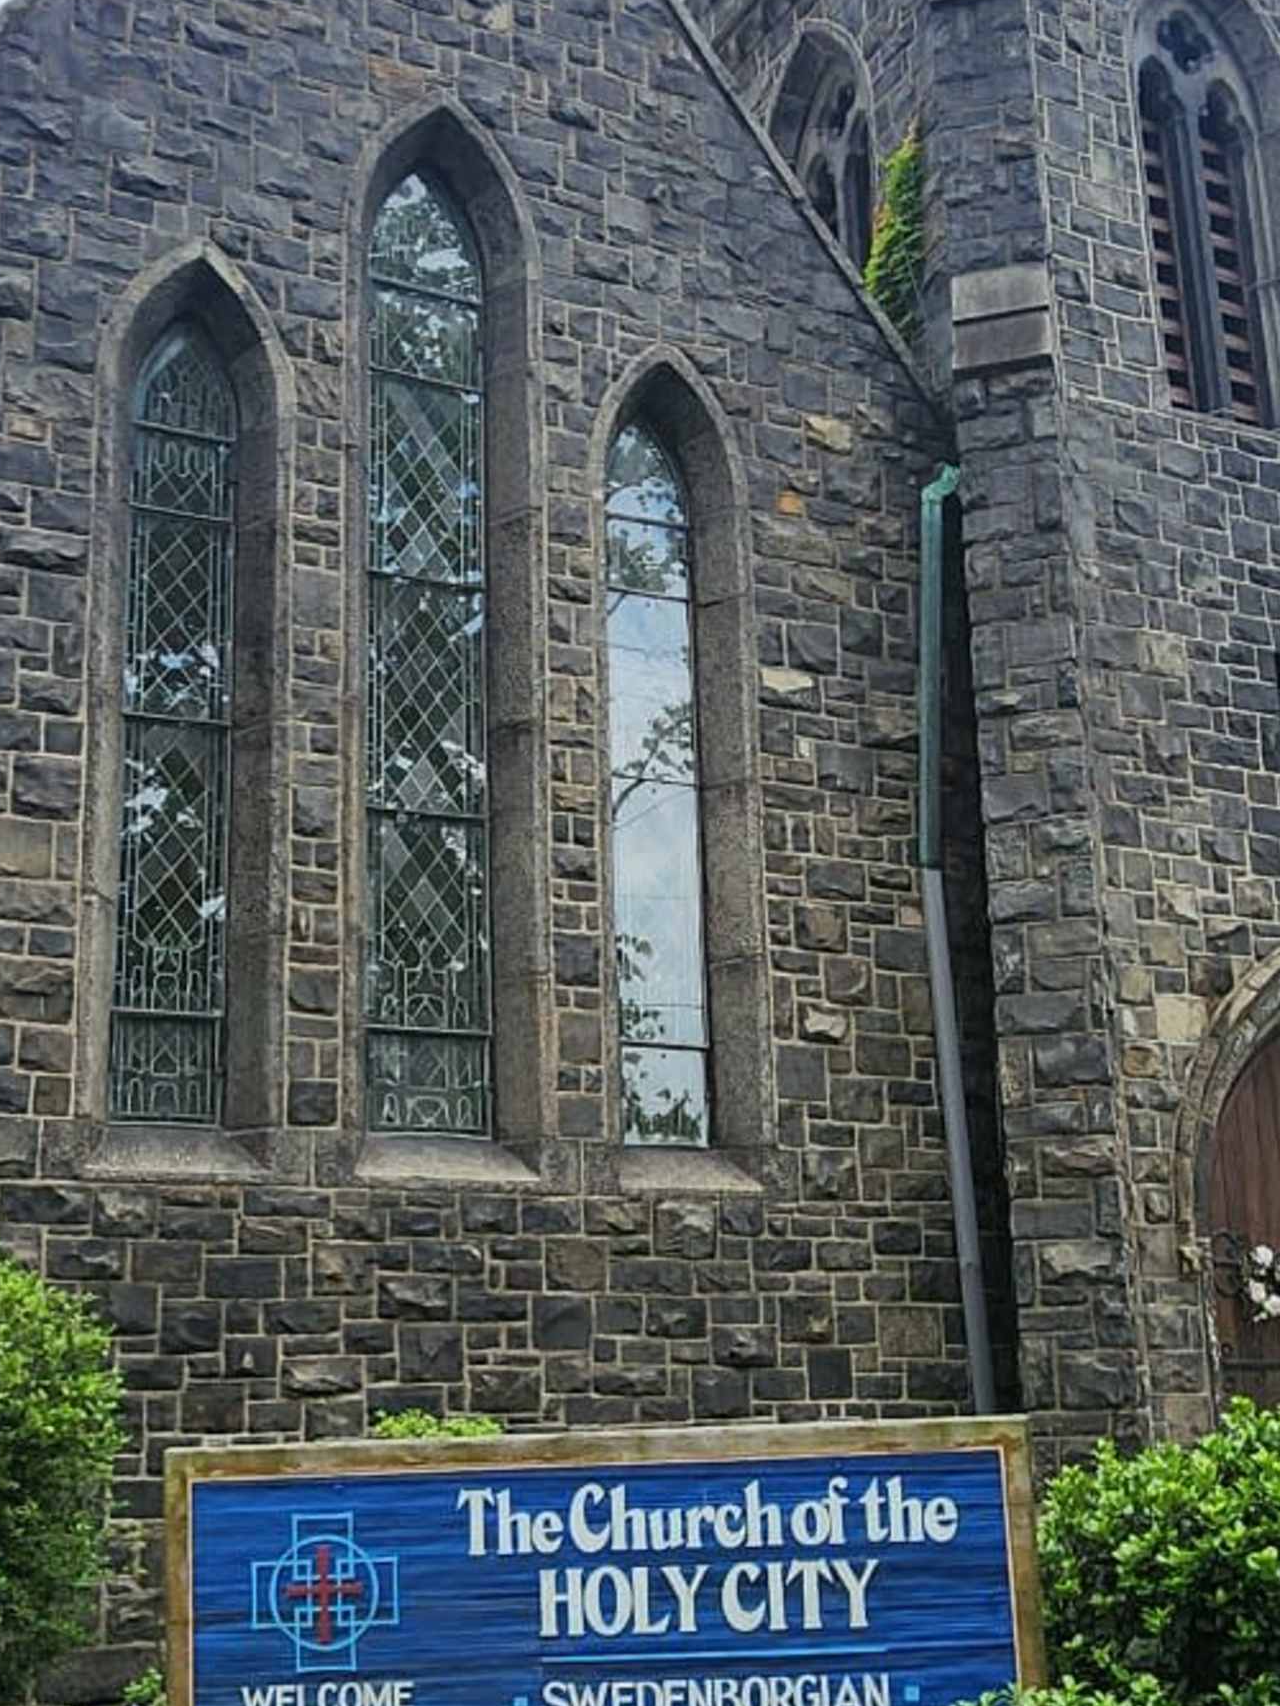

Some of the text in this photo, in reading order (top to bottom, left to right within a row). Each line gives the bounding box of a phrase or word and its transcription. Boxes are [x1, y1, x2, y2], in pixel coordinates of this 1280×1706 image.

[457, 1474, 959, 1558] The Church of the
[539, 1557, 880, 1638] HOLY CITY
